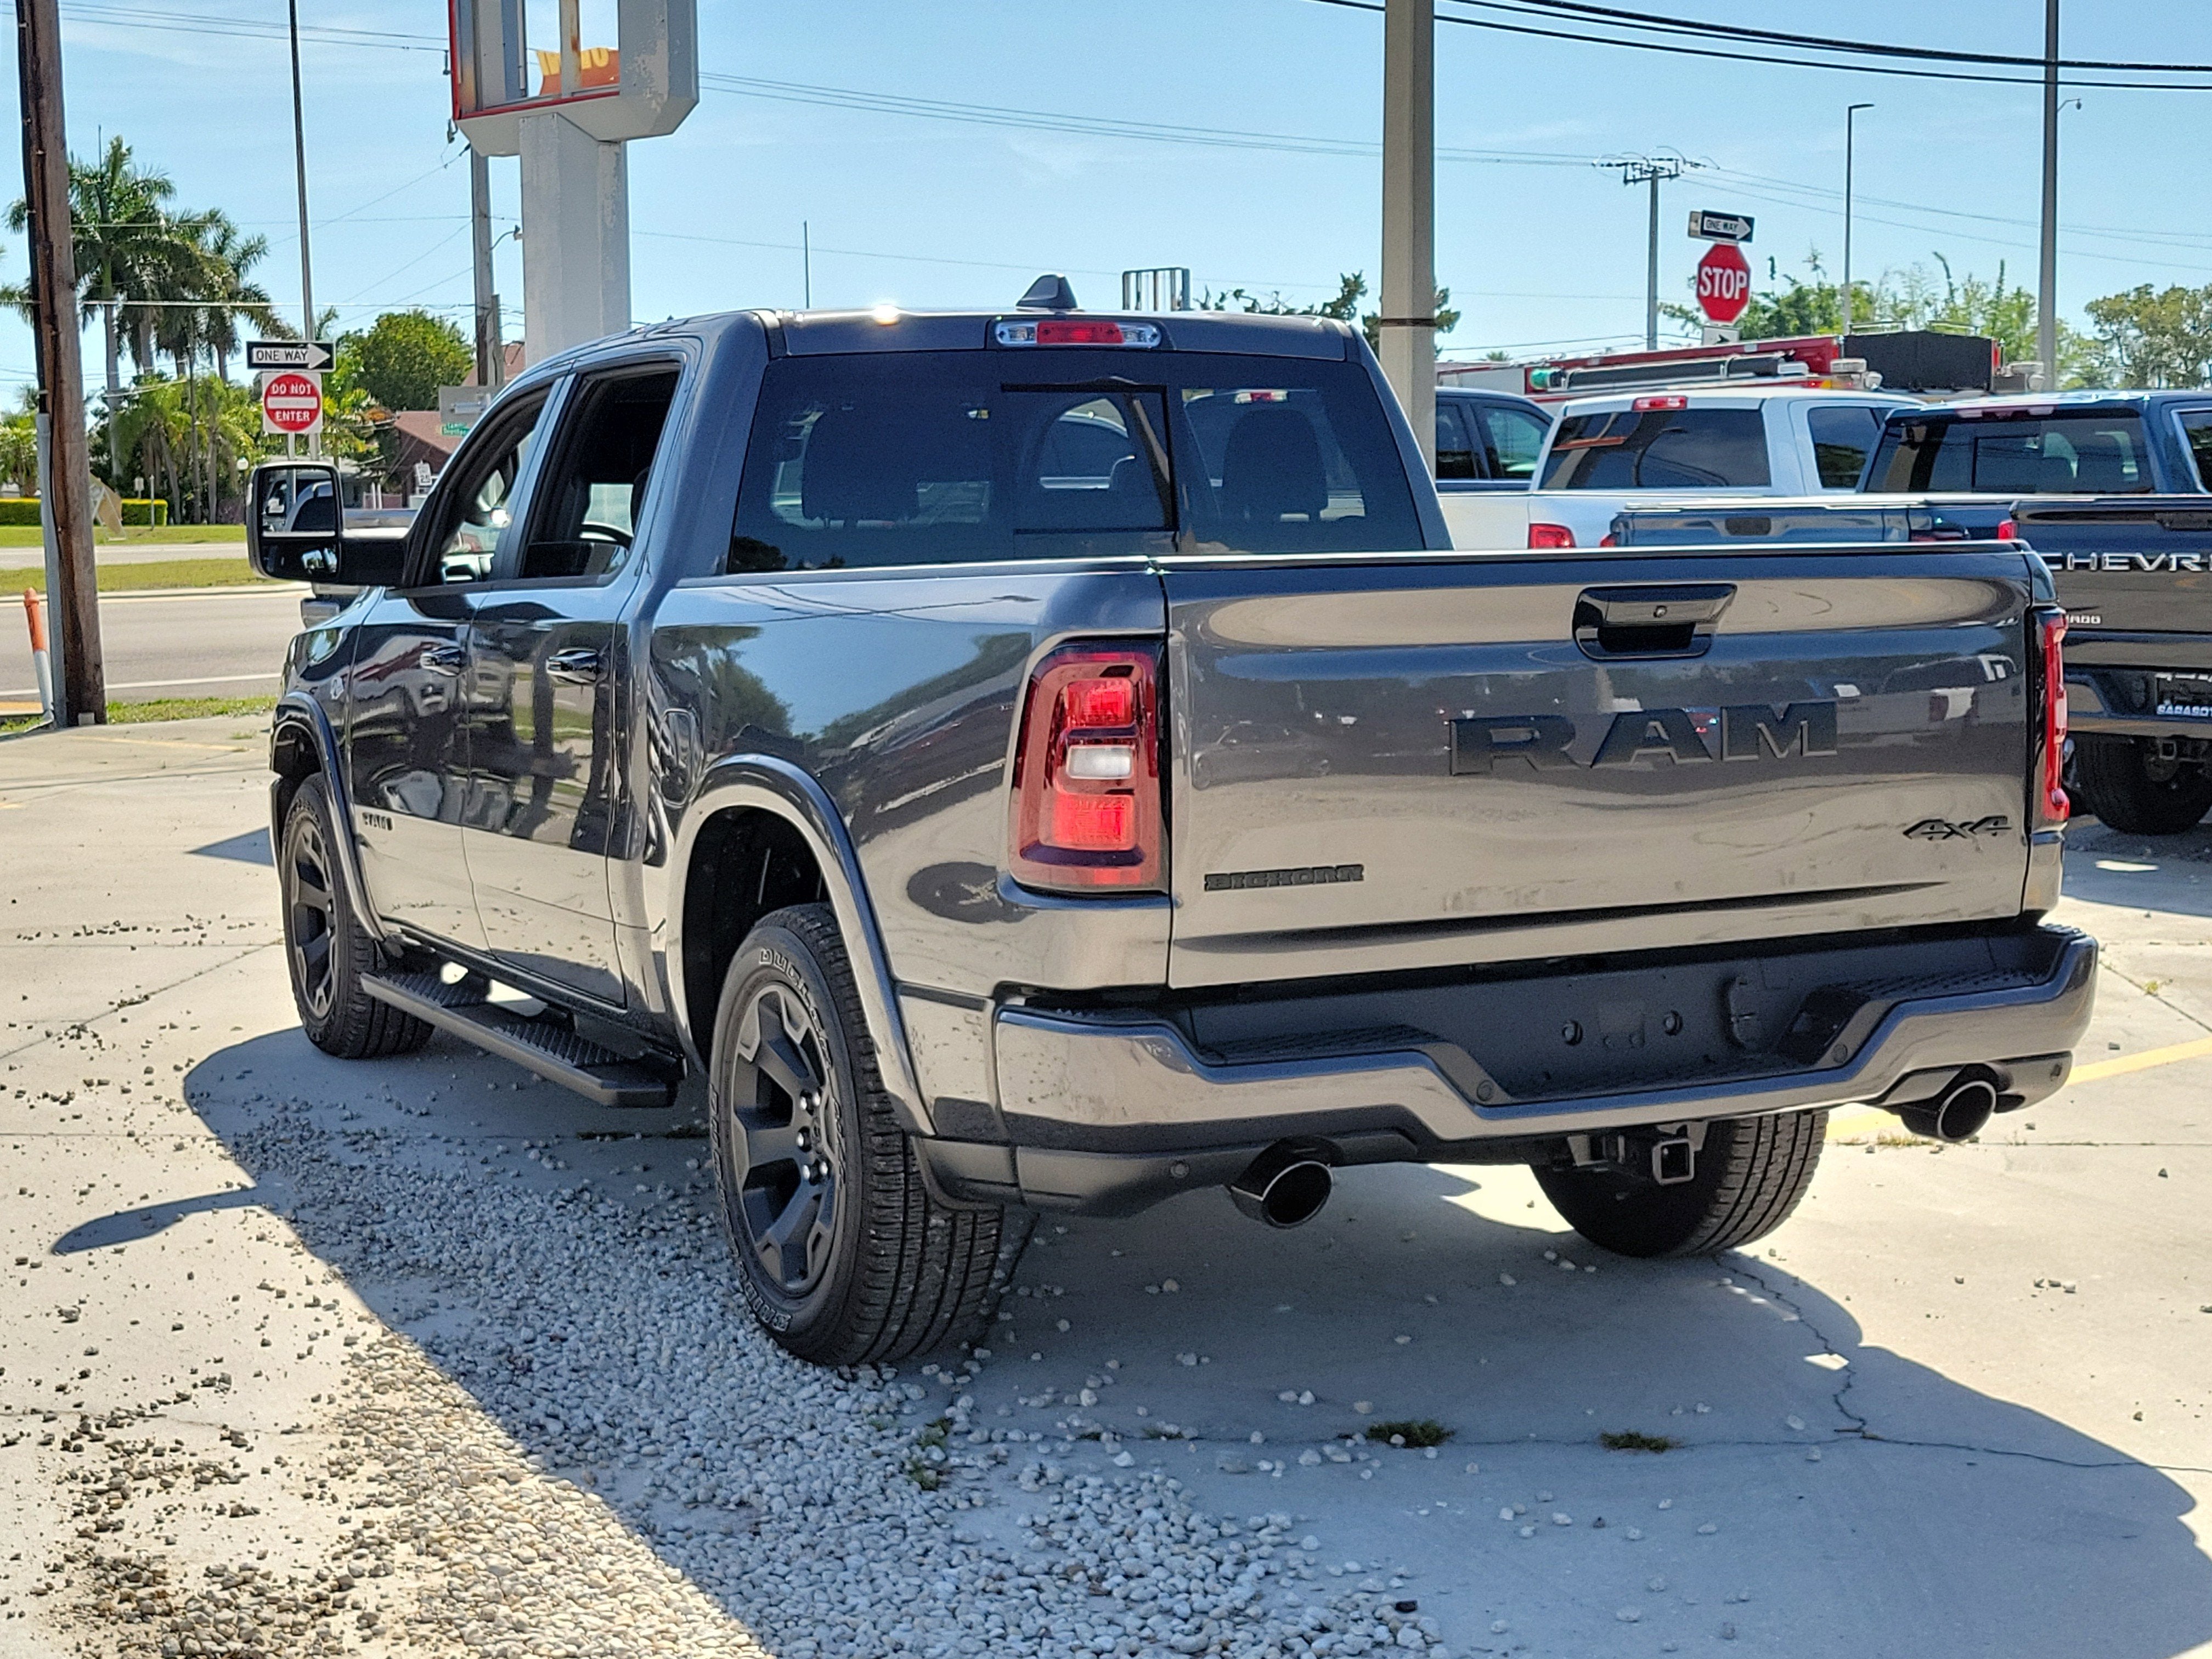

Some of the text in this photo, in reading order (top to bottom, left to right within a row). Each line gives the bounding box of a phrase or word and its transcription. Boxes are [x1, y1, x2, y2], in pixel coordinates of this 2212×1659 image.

[1706, 219, 1739, 232] ONE WAY
[1699, 266, 1747, 300] STOP
[256, 350, 308, 362] ONE WAY
[272, 382, 312, 395] DO NOT
[275, 410, 311, 422] ENTER
[1448, 700, 1838, 776] RAM
